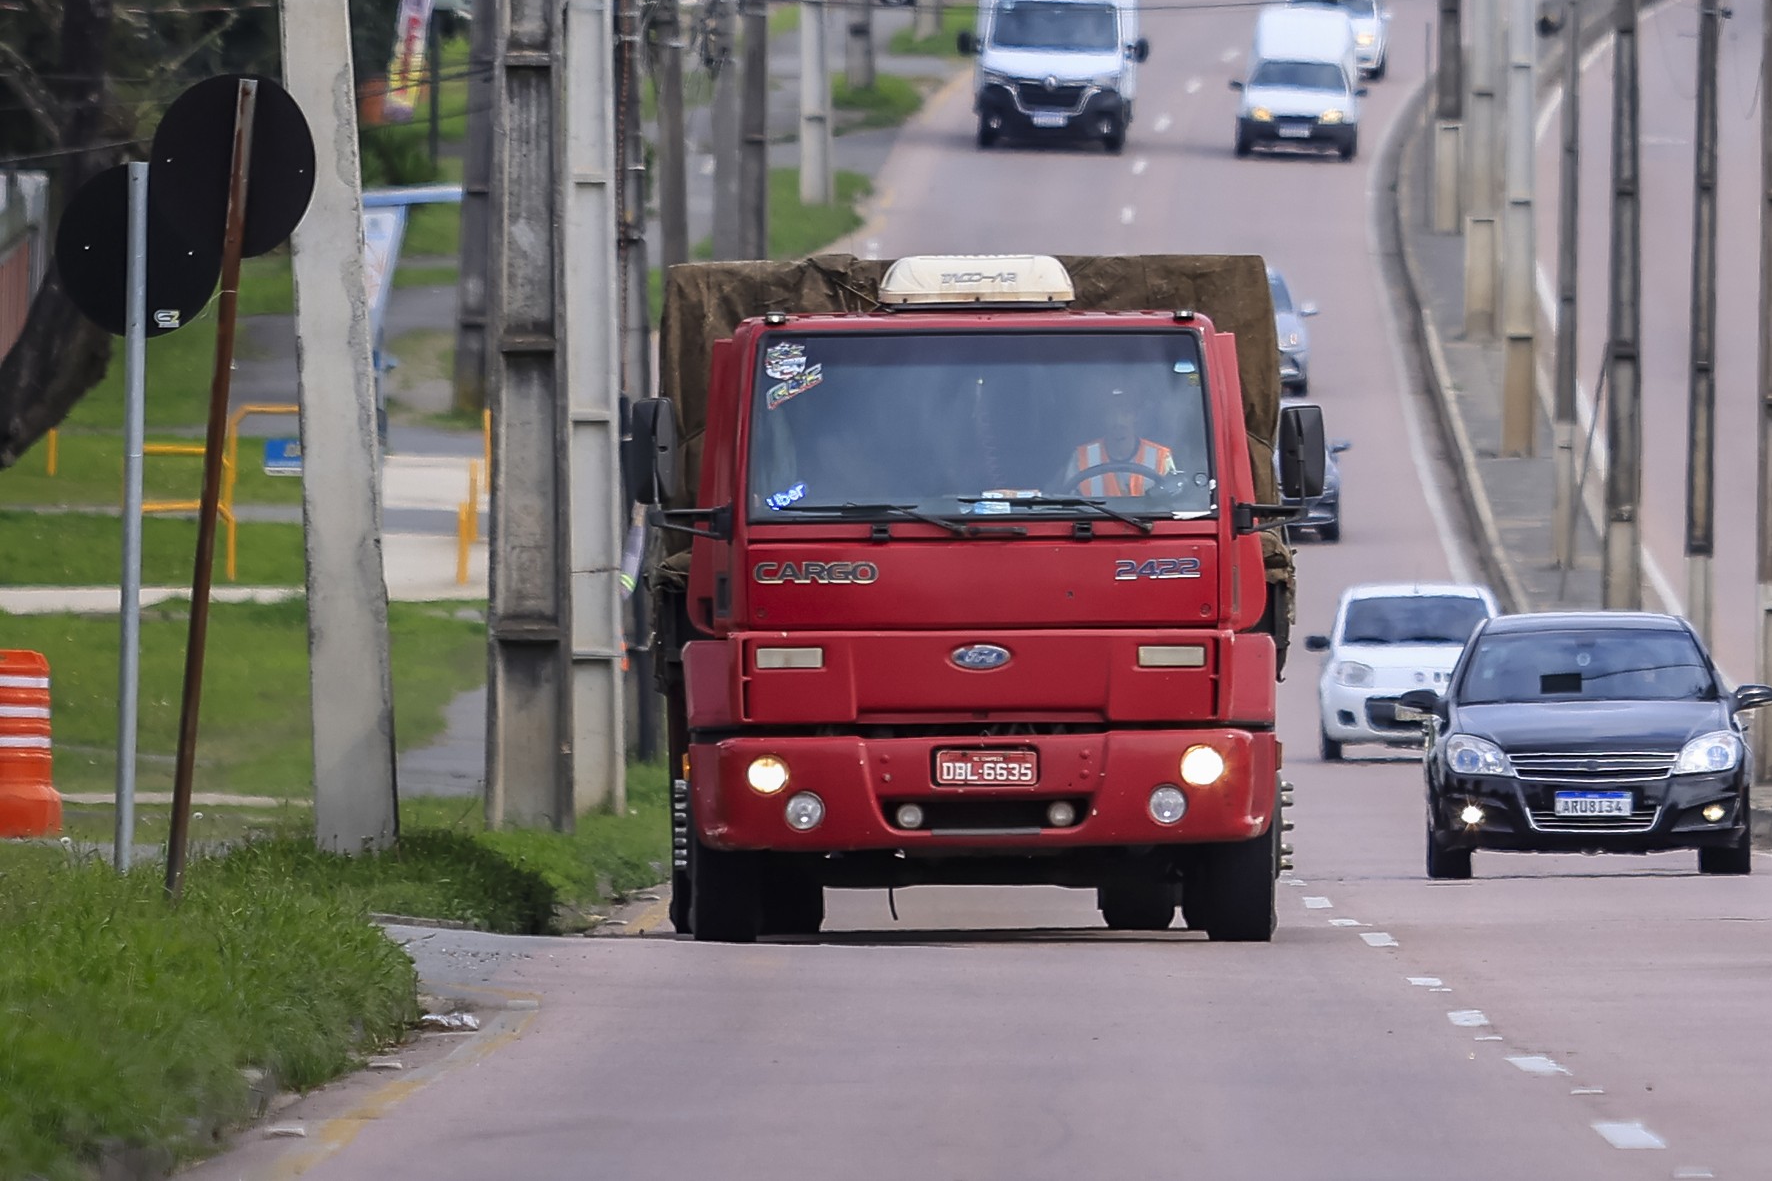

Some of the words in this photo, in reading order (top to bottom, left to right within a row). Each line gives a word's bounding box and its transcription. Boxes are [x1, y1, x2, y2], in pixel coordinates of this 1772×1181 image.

[753, 562, 879, 584] CARGO
[1115, 558, 1201, 580] 2422
[964, 650, 999, 664] Ford
